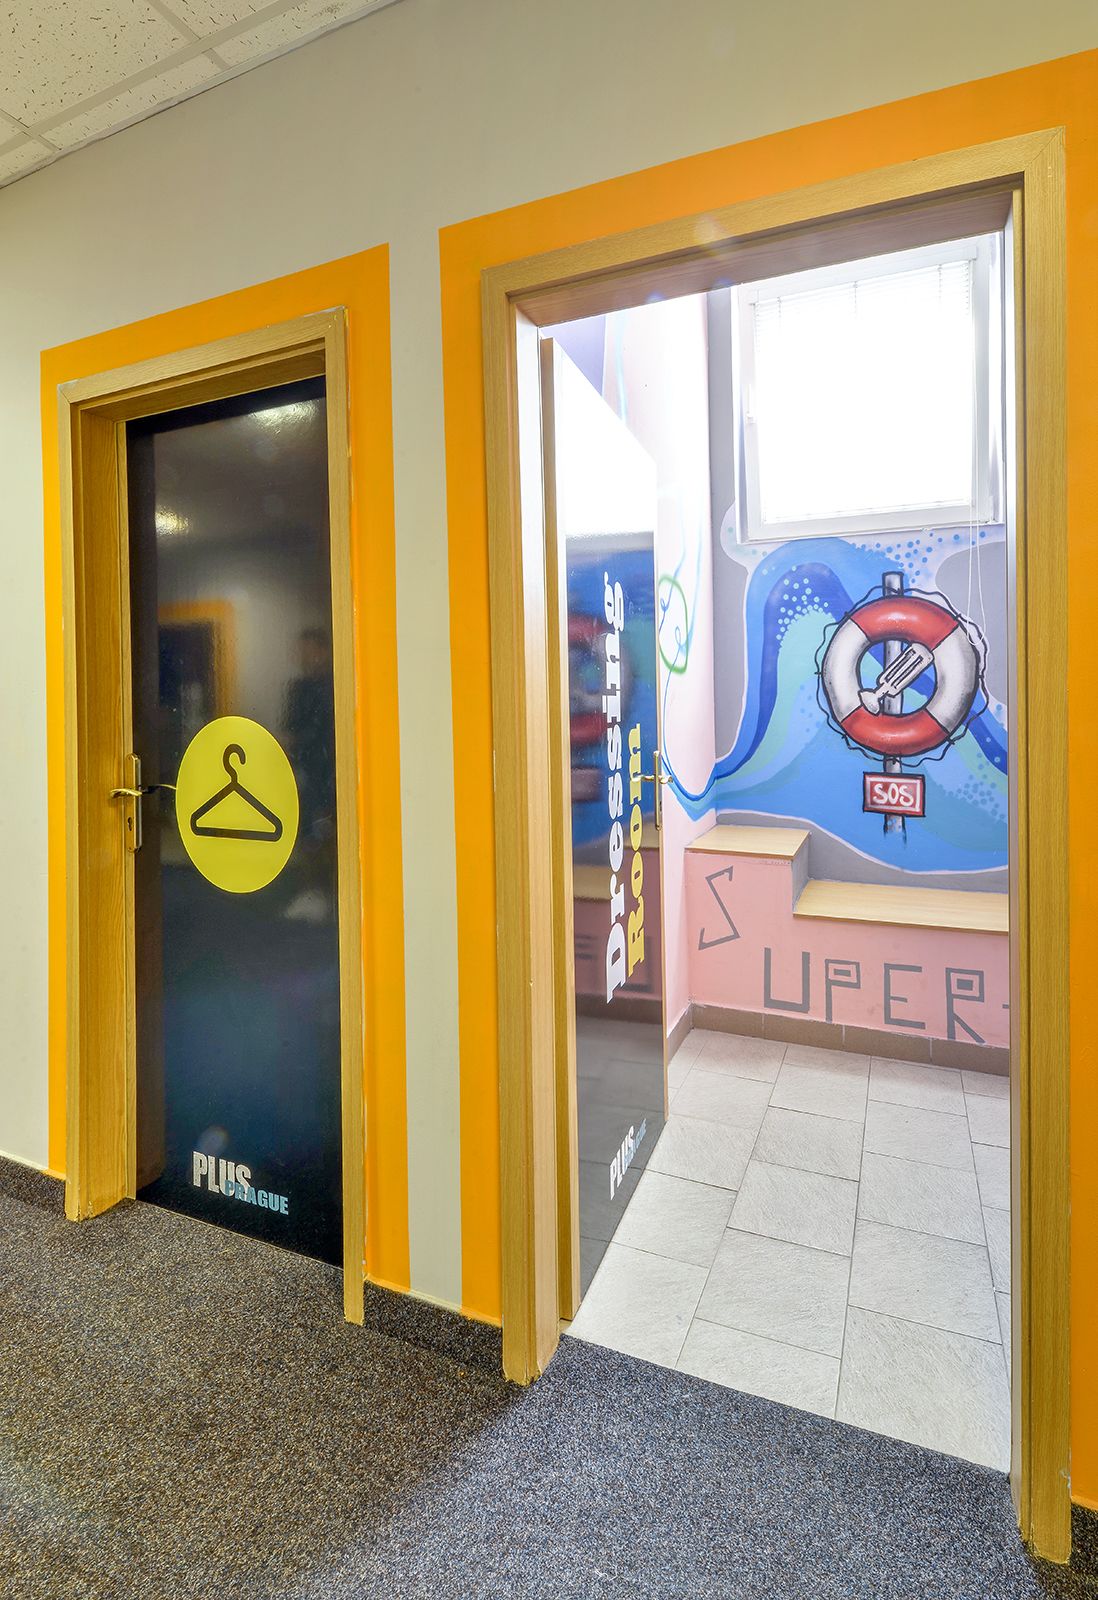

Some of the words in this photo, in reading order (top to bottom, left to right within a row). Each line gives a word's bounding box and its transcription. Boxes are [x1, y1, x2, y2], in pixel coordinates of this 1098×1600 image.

[604, 571, 626, 1003] Dressing
[872, 782, 914, 807] SOS
[627, 723, 645, 977] Room
[193, 1151, 251, 1200] PLUS
[609, 1125, 634, 1200] PLUS
[224, 1180, 289, 1215] PRAGUE
